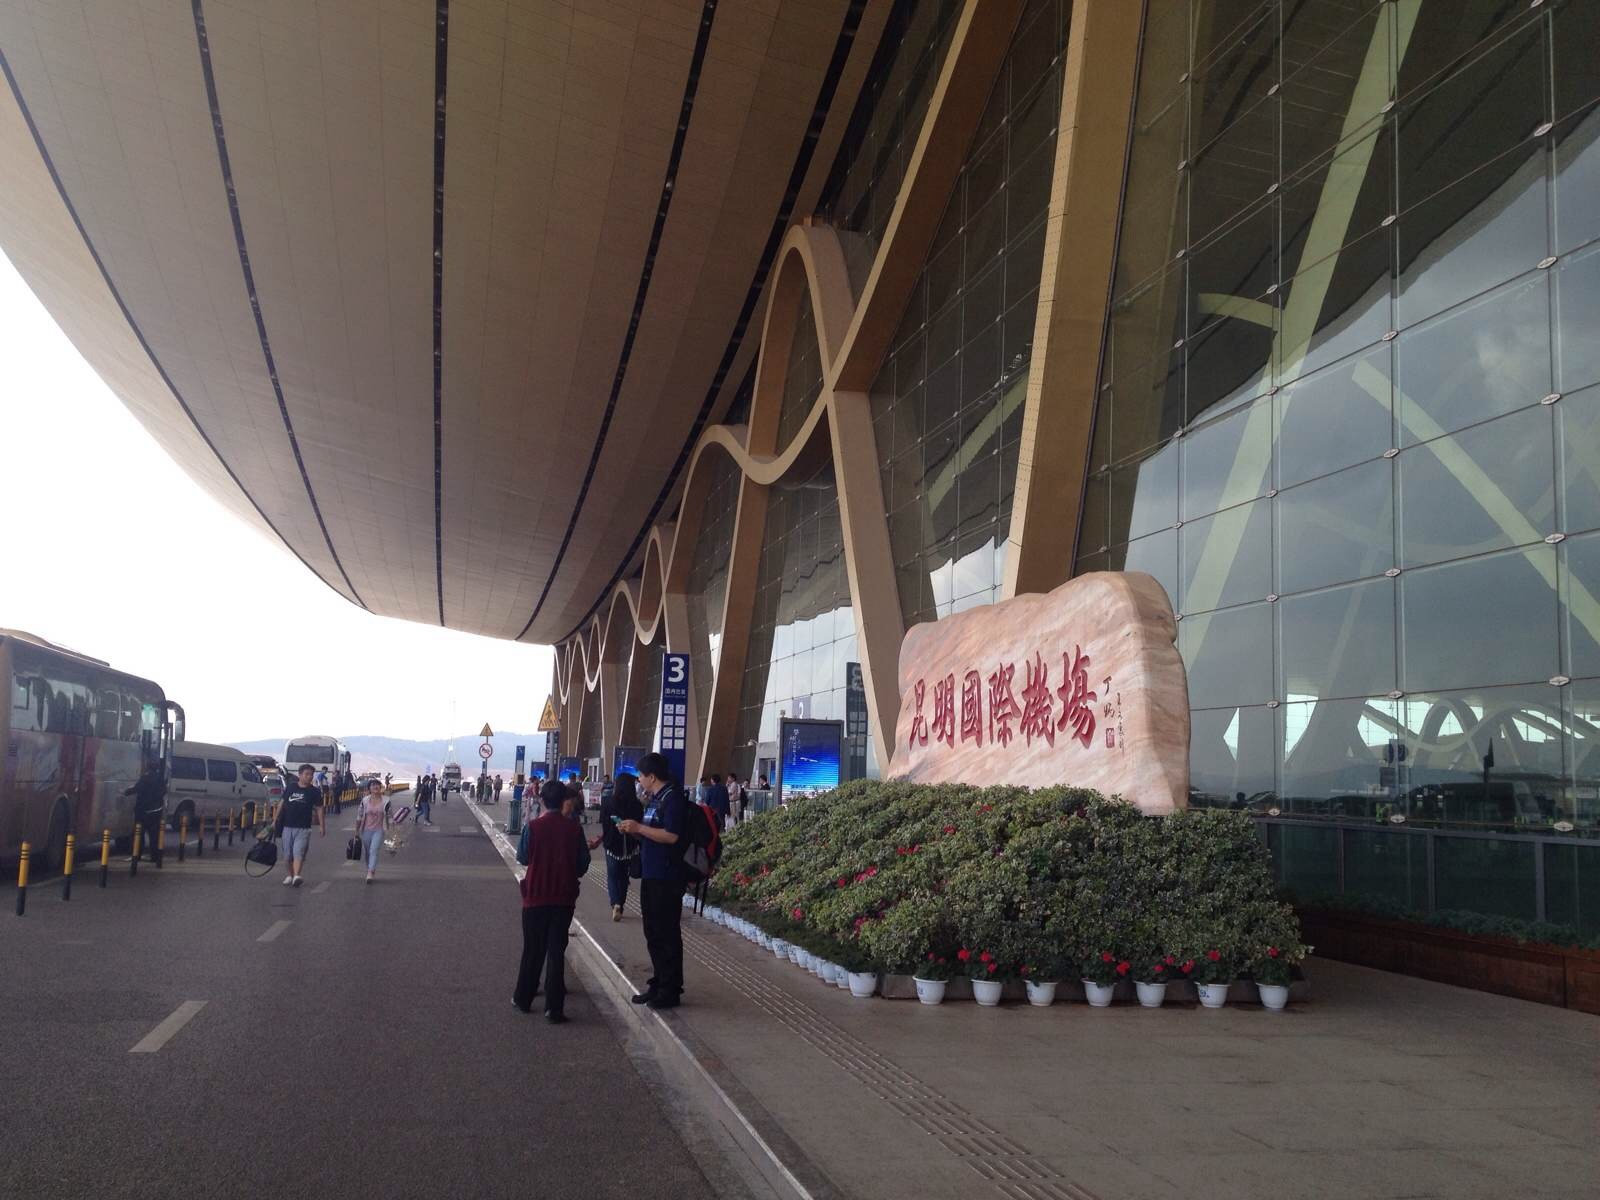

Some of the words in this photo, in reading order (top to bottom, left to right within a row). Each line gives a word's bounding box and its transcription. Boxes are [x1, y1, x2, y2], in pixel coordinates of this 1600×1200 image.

[668, 657, 685, 682] 3
[909, 644, 1098, 750] 昆明國際機場
